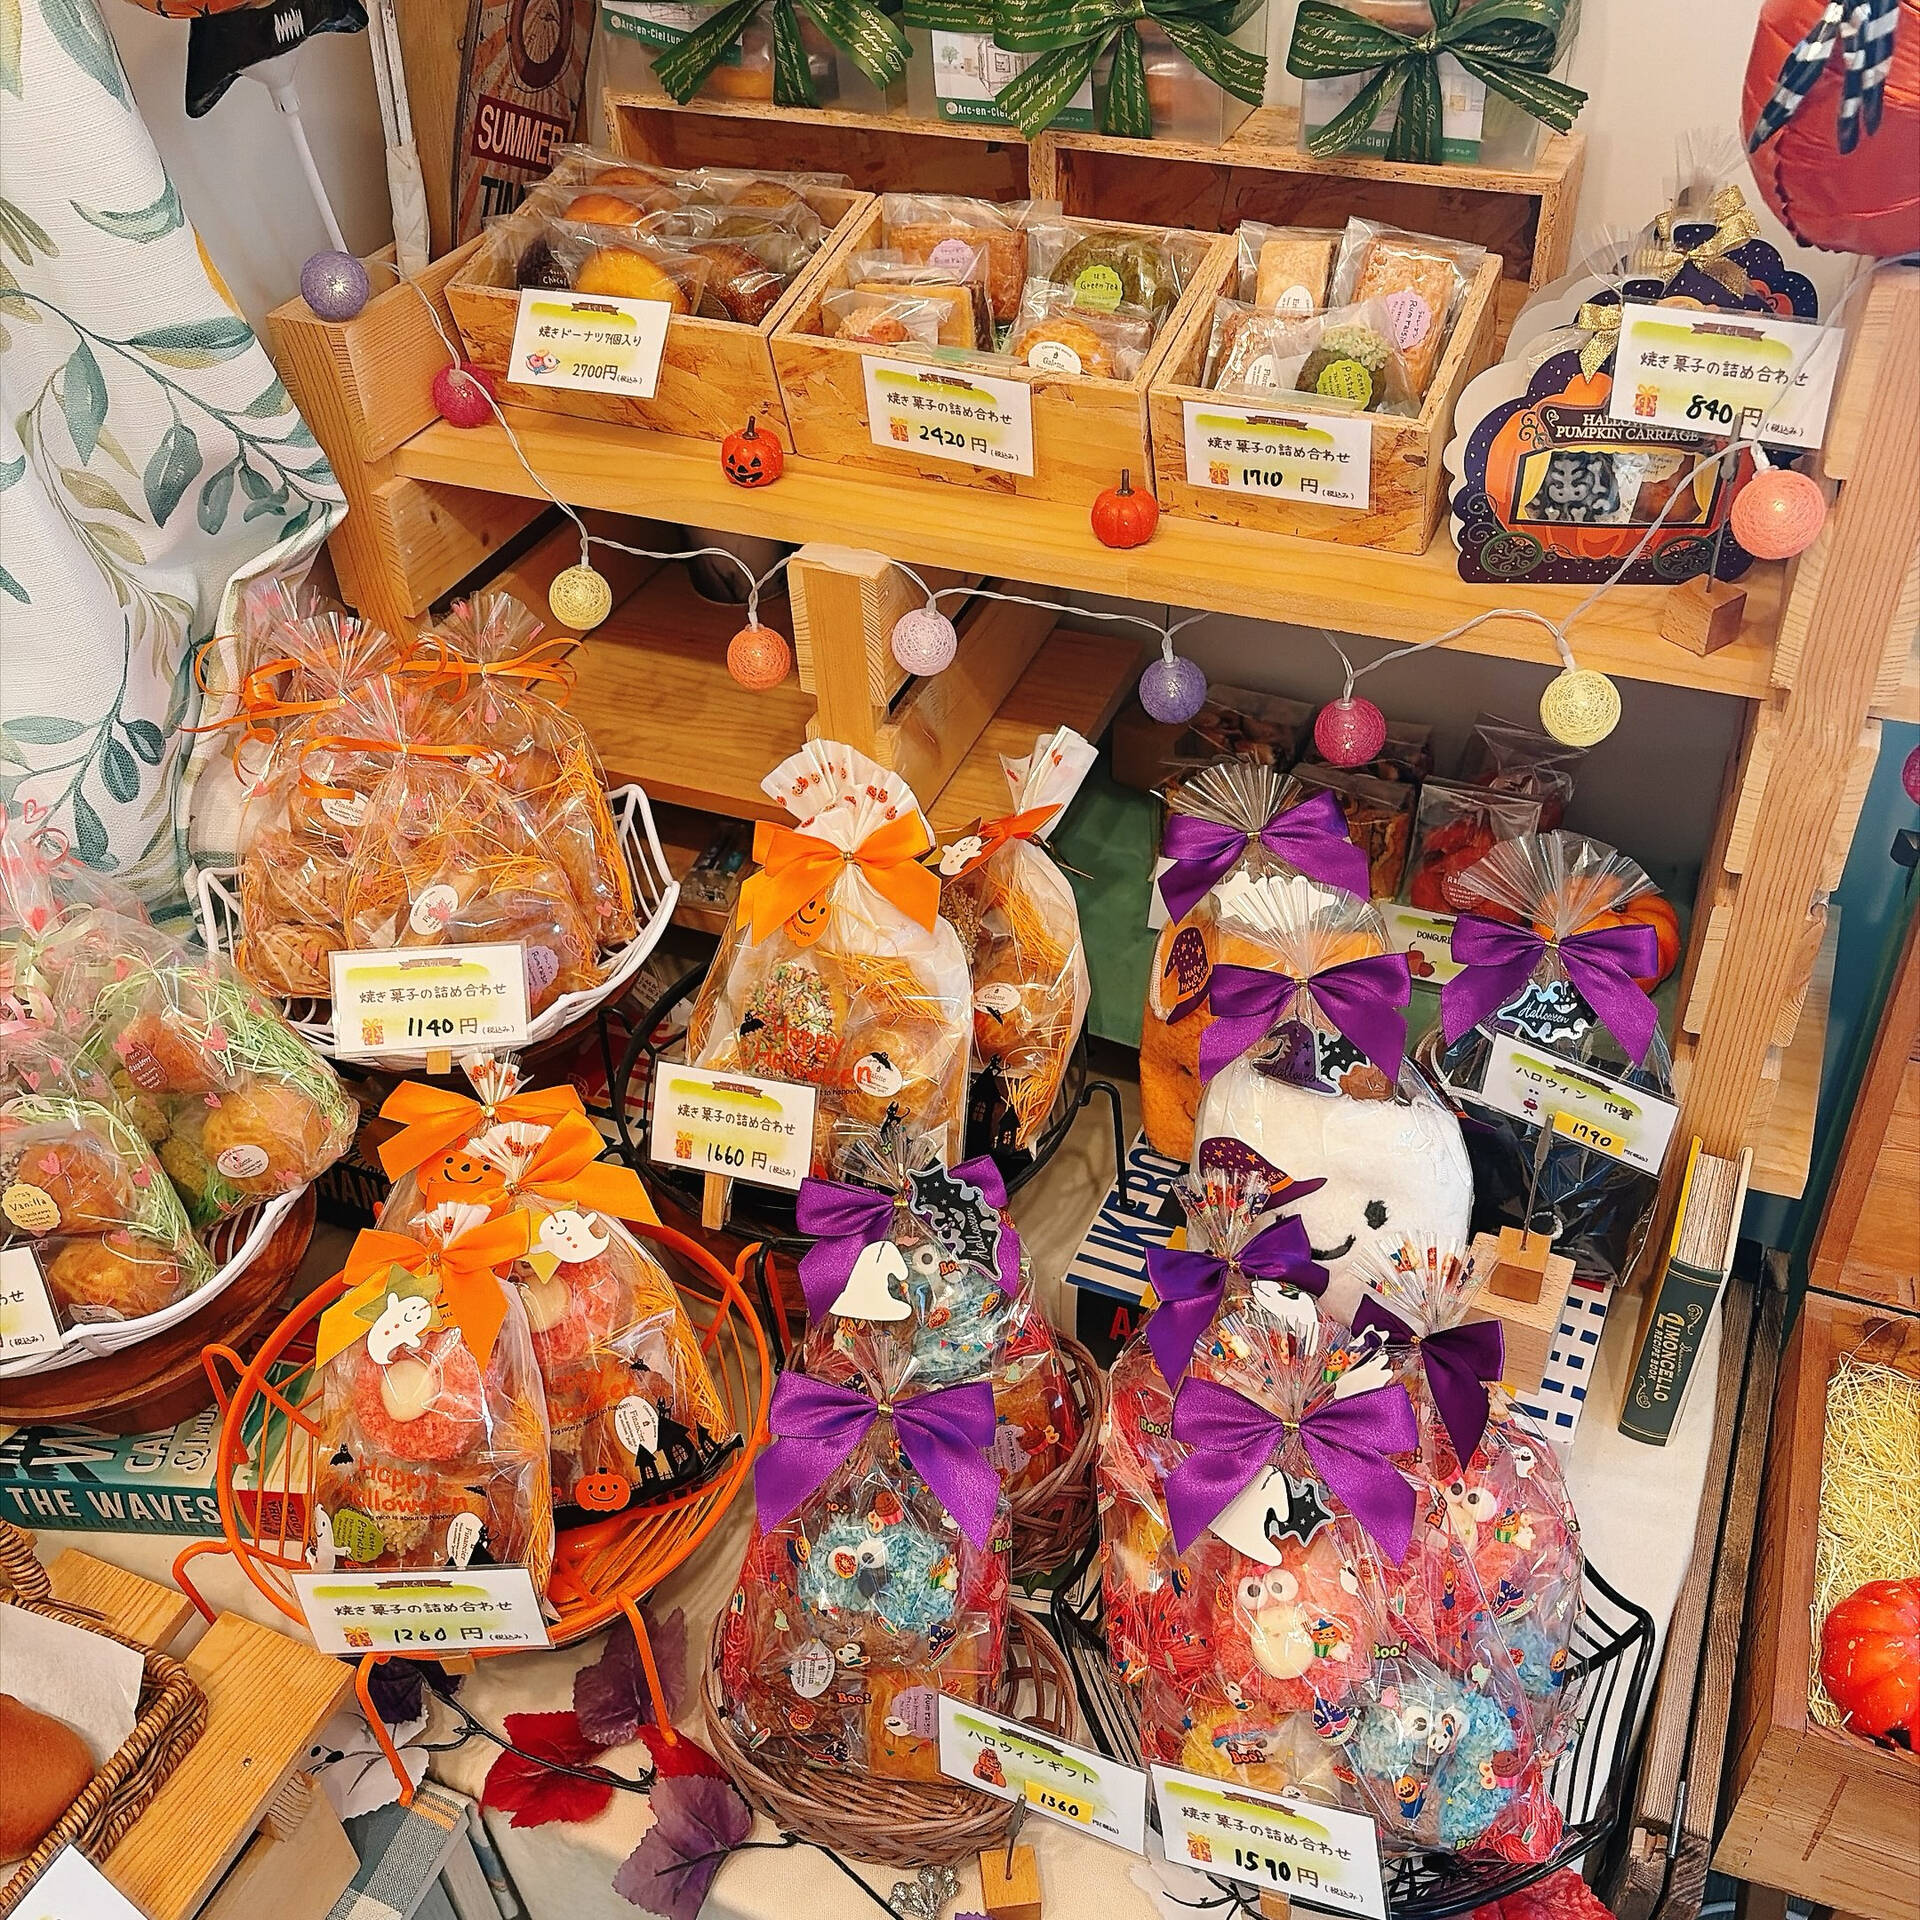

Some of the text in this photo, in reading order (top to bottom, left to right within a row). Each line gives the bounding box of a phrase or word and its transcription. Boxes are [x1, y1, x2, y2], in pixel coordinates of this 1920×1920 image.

[477, 103, 564, 165] SUMMER
[538, 325, 642, 347] 焼きドーナツ7個入り
[886, 392, 1013, 425] 焼き菓子の詰め合わせ
[1685, 394, 1733, 424] 840
[1741, 406, 1764, 427] 円
[919, 425, 965, 448] 2420
[971, 437, 987, 453] 円
[1555, 425, 1699, 442] PUMPKIN CARRIAGE
[1207, 437, 1351, 464] 焼き菓子の詰め合わせ
[1242, 469, 1284, 487] 1710
[1300, 477, 1319, 494] 円
[359, 982, 507, 1004] 焼き菓子の詰め合わせ
[1518, 1001, 1571, 1024] Halloween
[408, 1017, 454, 1037] 1140
[459, 1017, 478, 1035] 円
[1516, 1066, 1634, 1121] ハロウィン 巾着
[677, 1104, 796, 1136] 焼き菓子の詰め合わせ
[1572, 1122, 1612, 1147] 1790
[707, 1142, 744, 1167] 1660
[751, 1150, 768, 1171] 円
[9, 1198, 47, 1212] Vanilla
[965, 1207, 991, 1261] Halloween
[1647, 1327, 1664, 1382] RECIPE BOOK
[1653, 1311, 1686, 1403] LIMONCELLO
[1140, 1416, 1169, 1439] Boo!
[357, 1453, 438, 1495] Happy
[5, 1486, 82, 1517] THE
[85, 1490, 223, 1524] WAVES
[334, 1601, 513, 1616] 焼き菓子の詰め合わせ
[394, 1627, 447, 1643] 1260
[460, 1627, 484, 1640] 円
[837, 1691, 872, 1705] Boo!
[967, 1730, 1095, 1785] ハロウィンギフト
[1229, 1750, 1265, 1765] Boo!
[1040, 1792, 1079, 1817] 1360
[1180, 1805, 1352, 1862] 焼き菓子の詰め合わせ
[1234, 1848, 1292, 1883] 1590
[1297, 1867, 1319, 1889] 円
